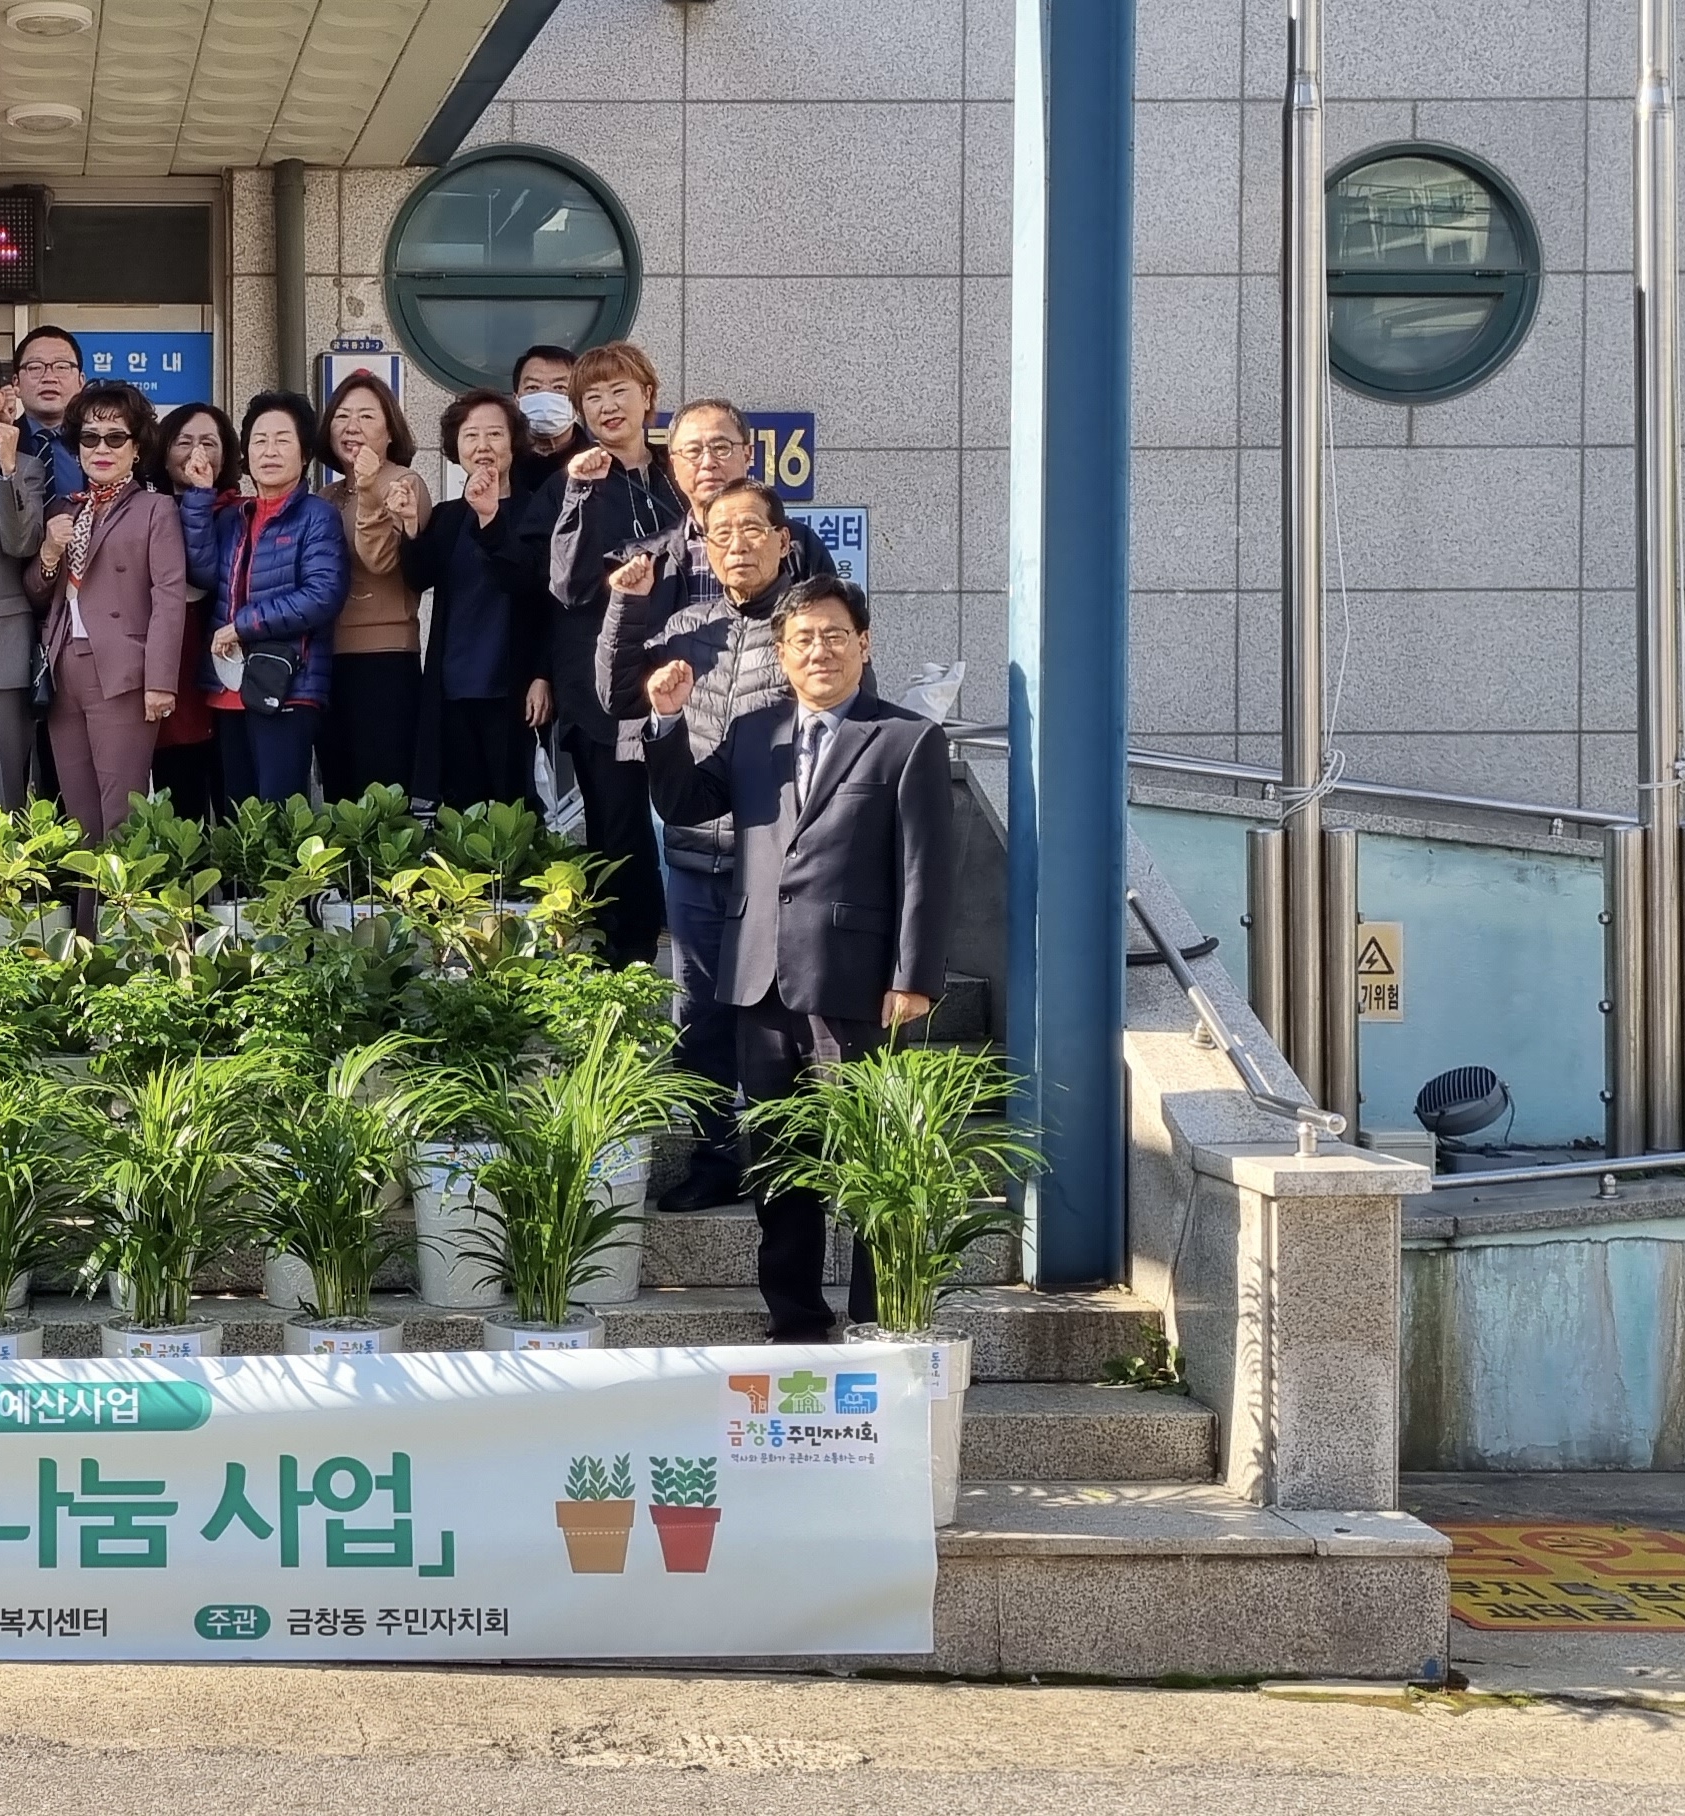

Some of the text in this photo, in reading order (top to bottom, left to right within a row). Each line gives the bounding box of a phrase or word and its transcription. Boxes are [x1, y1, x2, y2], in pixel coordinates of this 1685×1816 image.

[758, 429, 811, 487] 16
[1361, 983, 1399, 1011] 기위험
[206, 1607, 509, 1637] 주관 금창동 주민자치회
